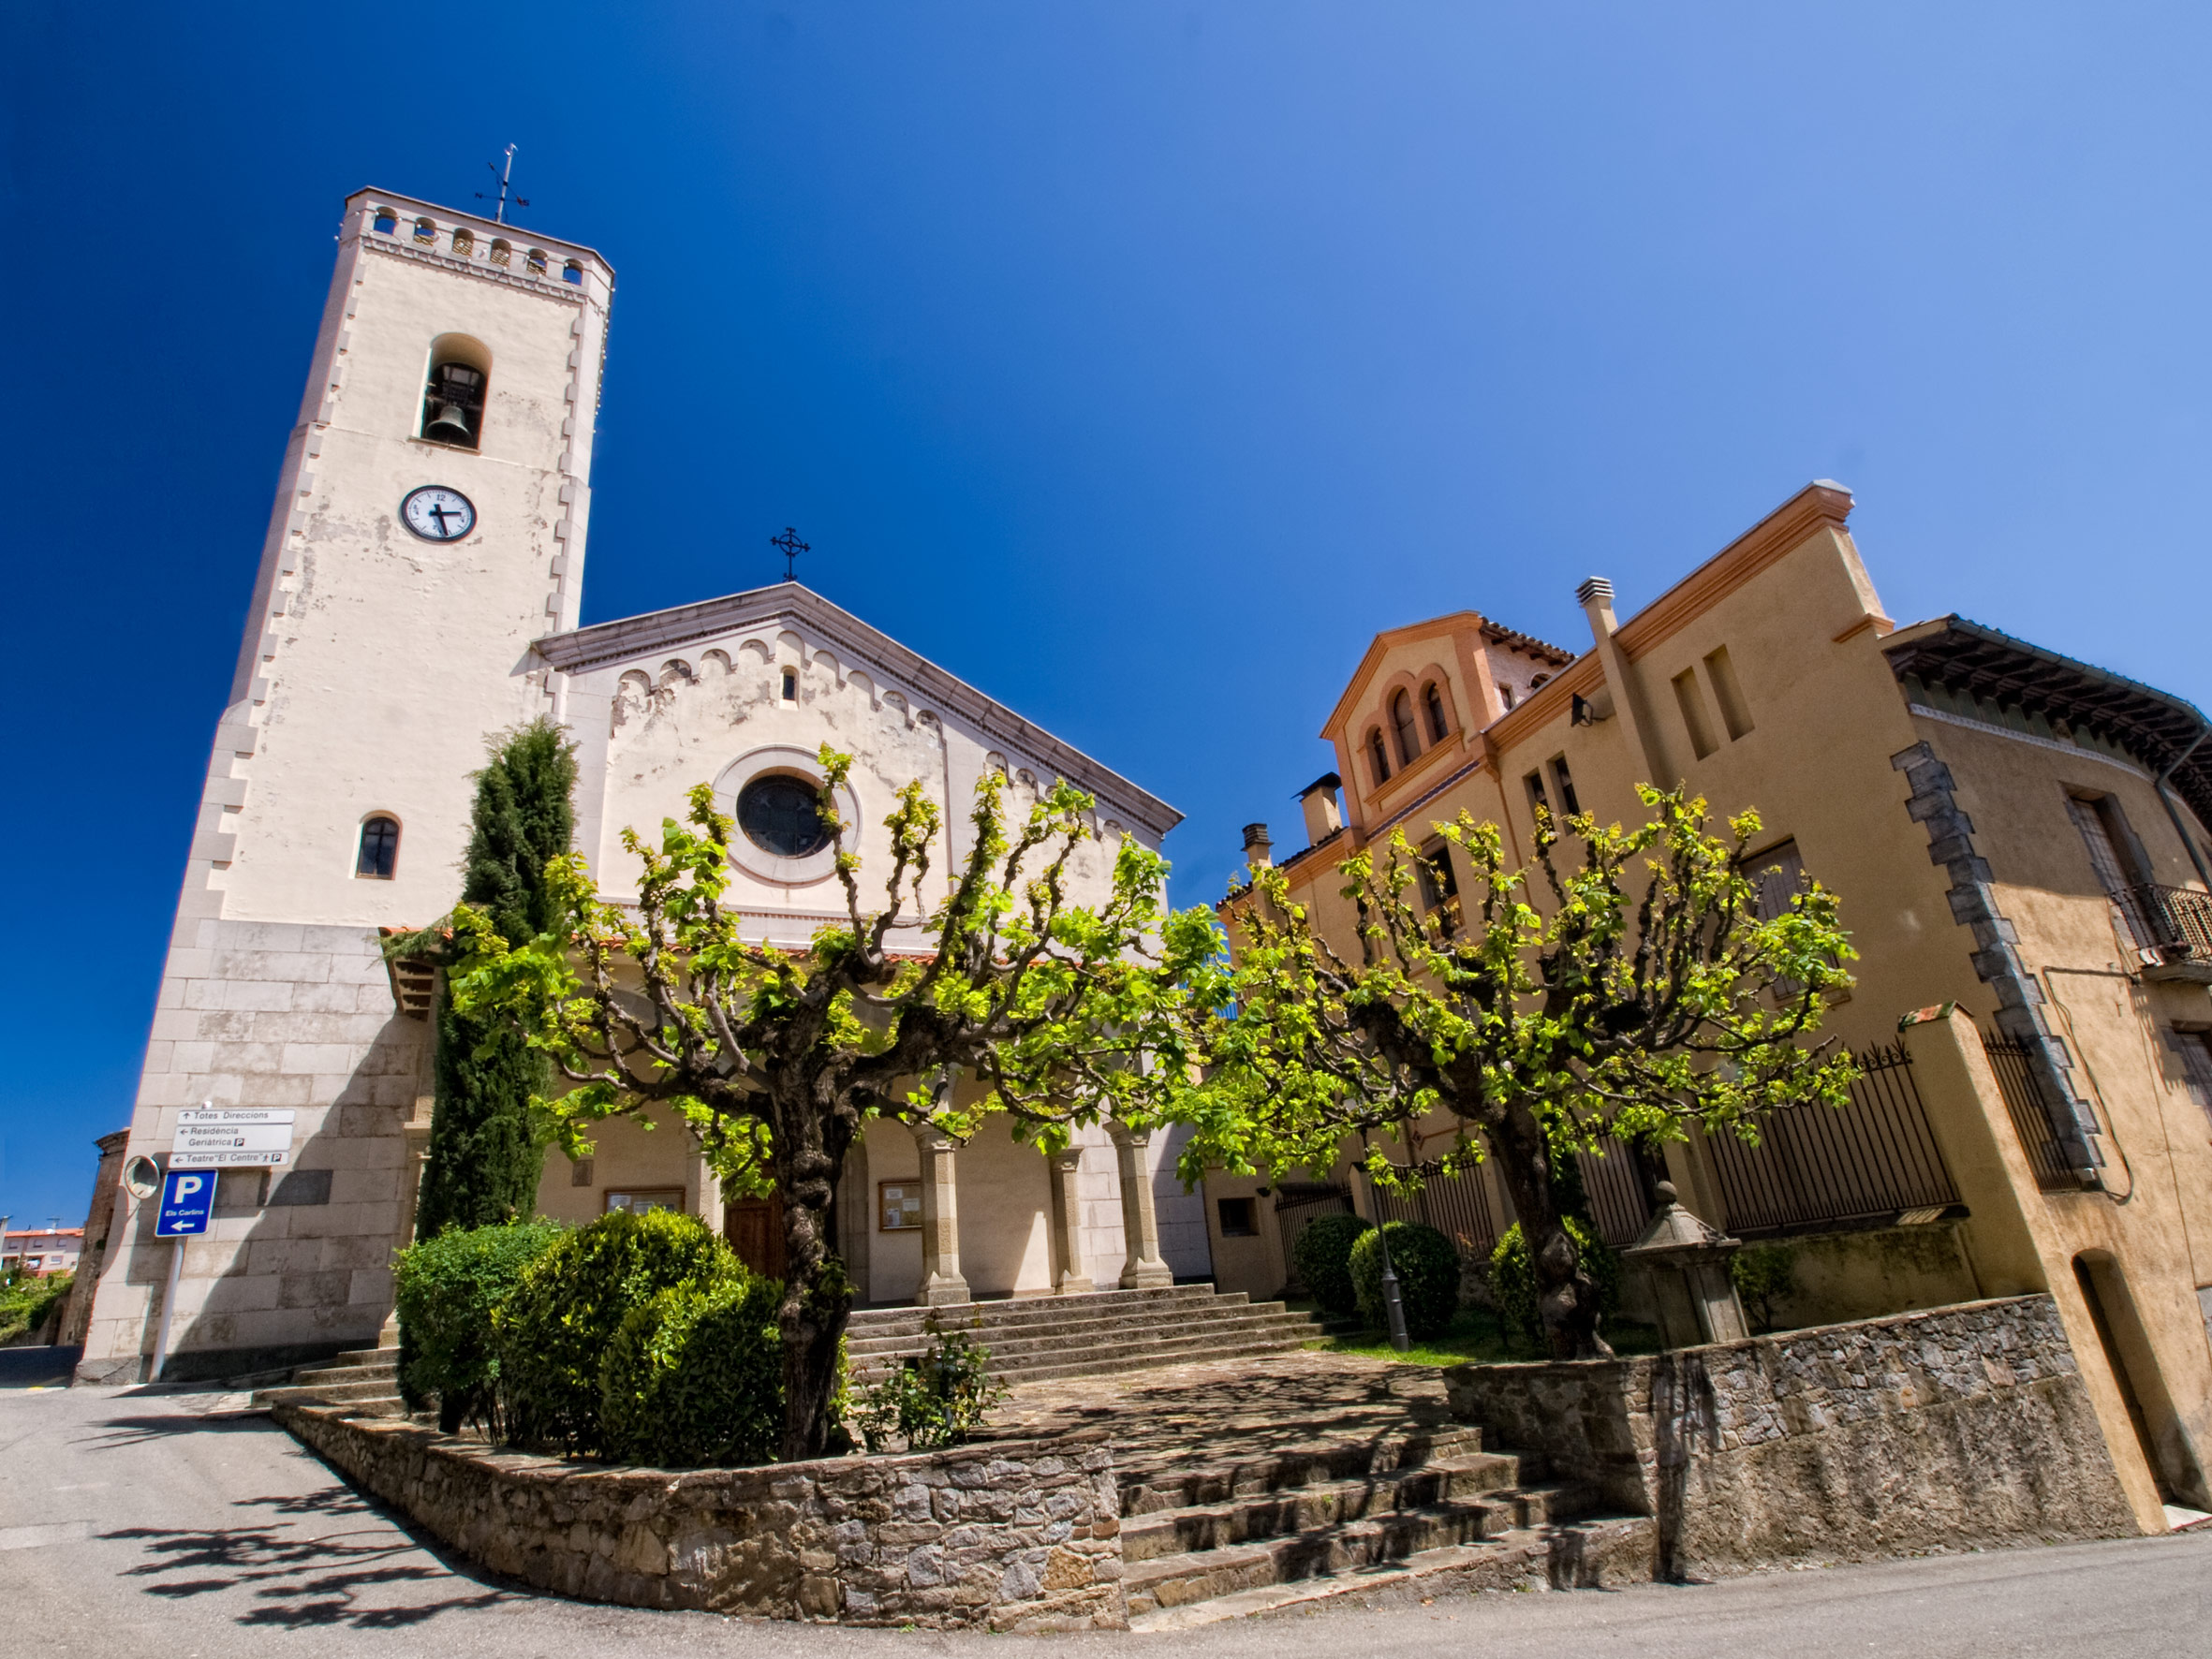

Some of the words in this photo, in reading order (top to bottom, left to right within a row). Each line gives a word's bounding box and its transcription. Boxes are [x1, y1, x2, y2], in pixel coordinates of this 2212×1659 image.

[436, 493, 446, 502] 12
[194, 1111, 218, 1120] Totes
[223, 1111, 269, 1120] Direccions
[174, 1176, 202, 1204] P
